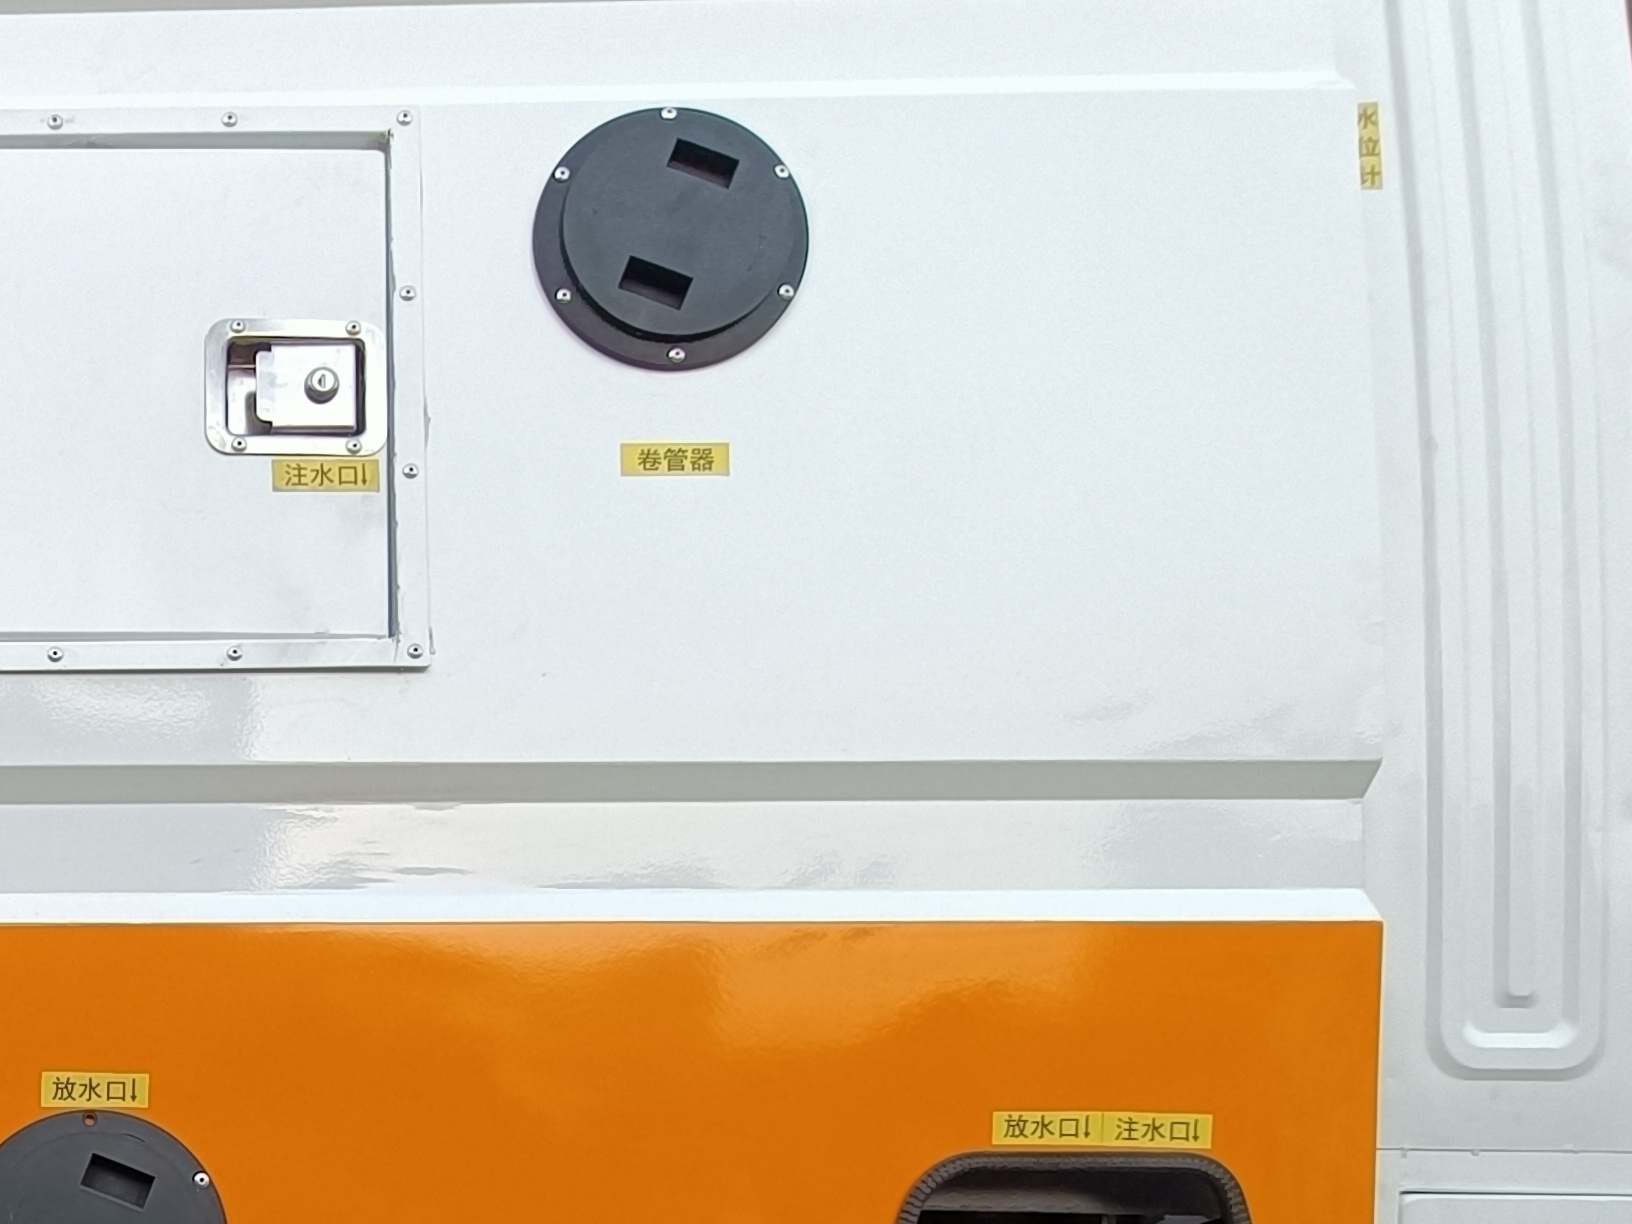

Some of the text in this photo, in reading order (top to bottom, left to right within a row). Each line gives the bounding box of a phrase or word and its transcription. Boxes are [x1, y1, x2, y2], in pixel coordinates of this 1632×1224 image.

[637, 448, 715, 472] 卷管器
[284, 463, 359, 487] 注水口
[51, 1075, 126, 1101] 放水口
[1003, 1114, 1079, 1139] 放水口
[1114, 1117, 1190, 1142] 注水口
